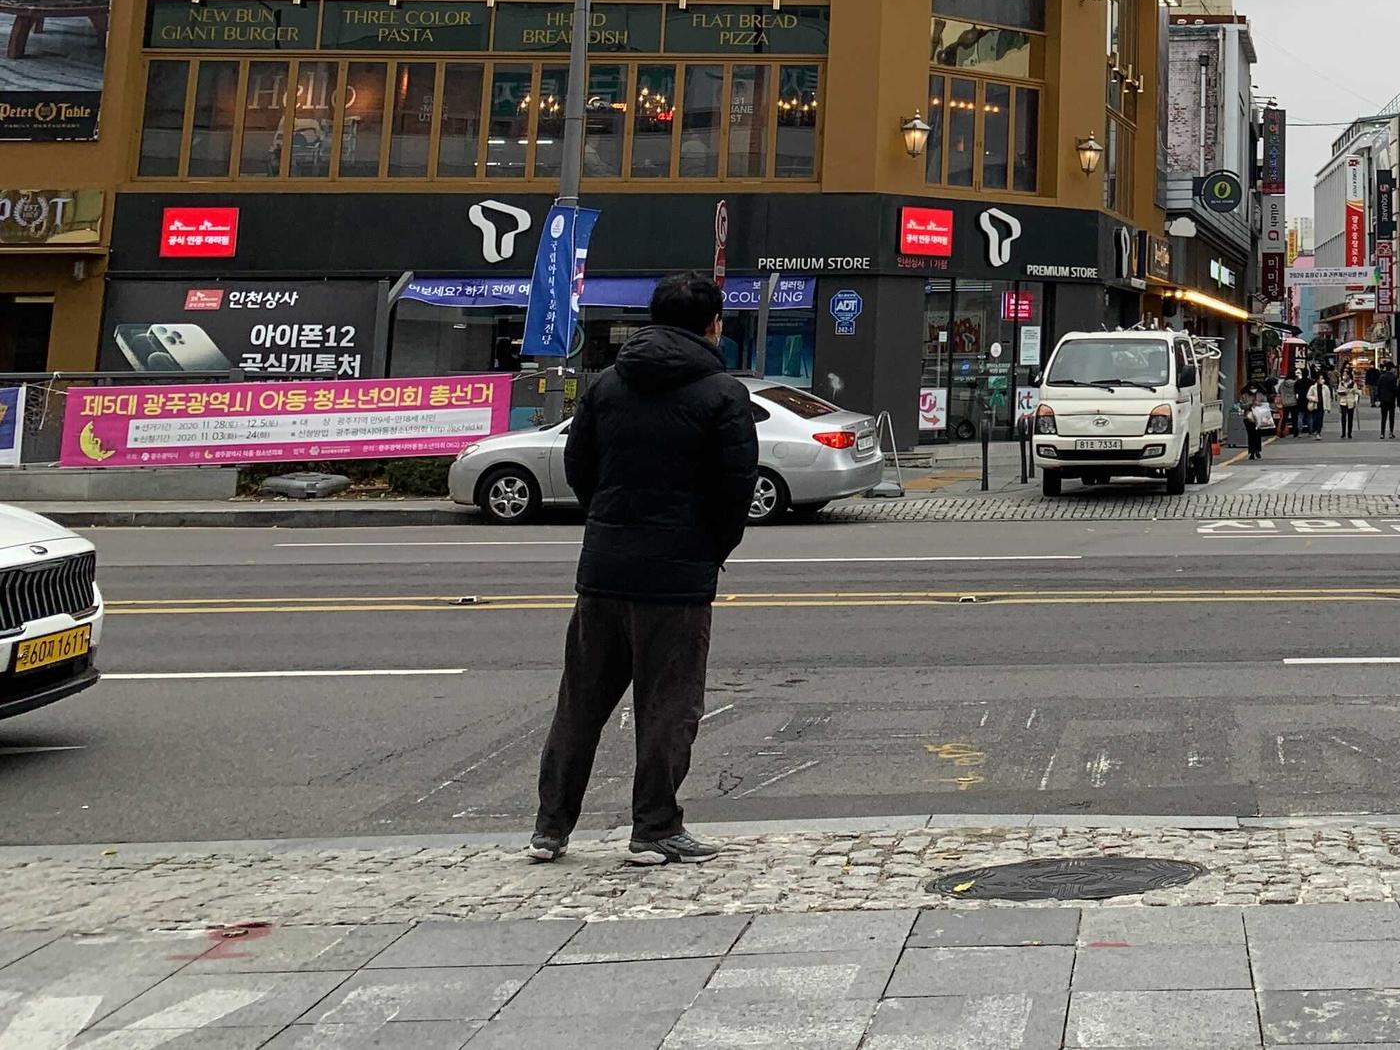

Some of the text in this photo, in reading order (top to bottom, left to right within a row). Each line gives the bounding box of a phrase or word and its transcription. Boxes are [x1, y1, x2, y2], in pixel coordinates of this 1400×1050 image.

[188, 8, 275, 25] NEW BUN
[342, 10, 471, 26] THREE COLOR
[546, 12, 607, 28] HI-ED
[692, 13, 798, 29] FLAT BREAD
[161, 25, 299, 42] GIANT BURGER
[378, 28, 434, 43] PASTA
[522, 29, 628, 45] BREA DISH
[719, 31, 769, 46] PIZZA
[0, 102, 92, 121] Peter Table
[757, 257, 871, 270] PREMIUM STORE
[1026, 264, 1098, 279] PREMIUM STORE
[465, 284, 488, 296] 하기
[491, 284, 515, 296] 전에
[228, 291, 299, 309] 인천상사
[835, 300, 857, 311] ADT
[249, 323, 356, 349] 아이폰12
[239, 353, 361, 378] 공식개통처
[80, 394, 137, 417] 제5대
[143, 391, 251, 415] 광주광역시
[428, 382, 494, 406] 총선거
[1017, 391, 1034, 410] kt
[58, 629, 85, 657] 1611
